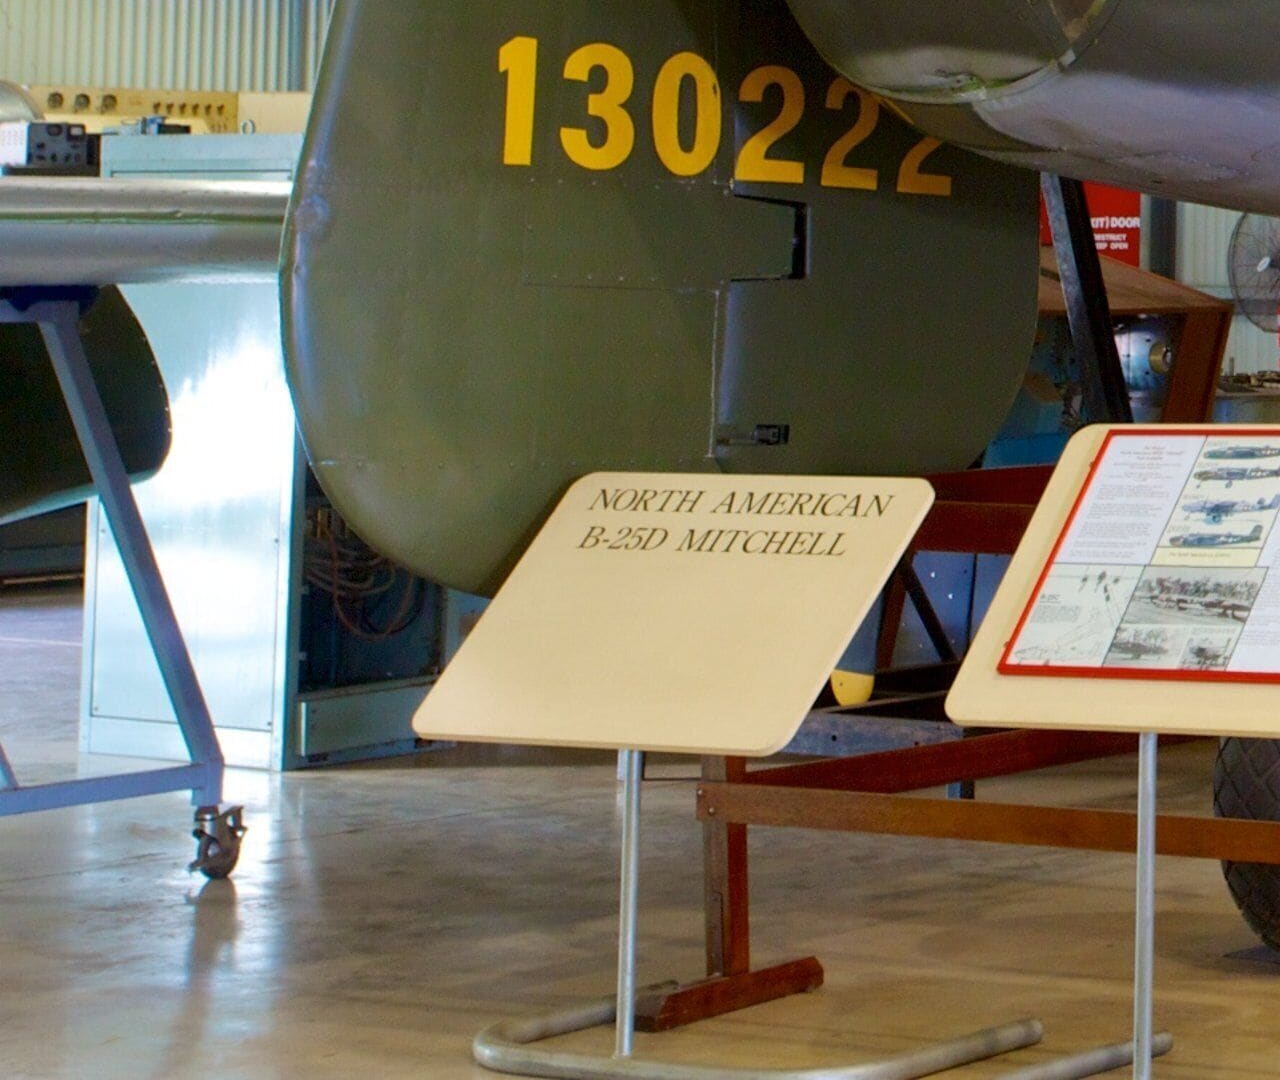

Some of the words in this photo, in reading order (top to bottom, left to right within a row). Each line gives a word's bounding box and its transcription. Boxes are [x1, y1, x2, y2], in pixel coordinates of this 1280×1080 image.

[1111, 217, 1140, 228] DOOR
[588, 488, 705, 513] NORTH
[711, 491, 895, 518] AMERICAN
[577, 526, 669, 551] B-25D
[675, 528, 847, 557] MITCHELL
